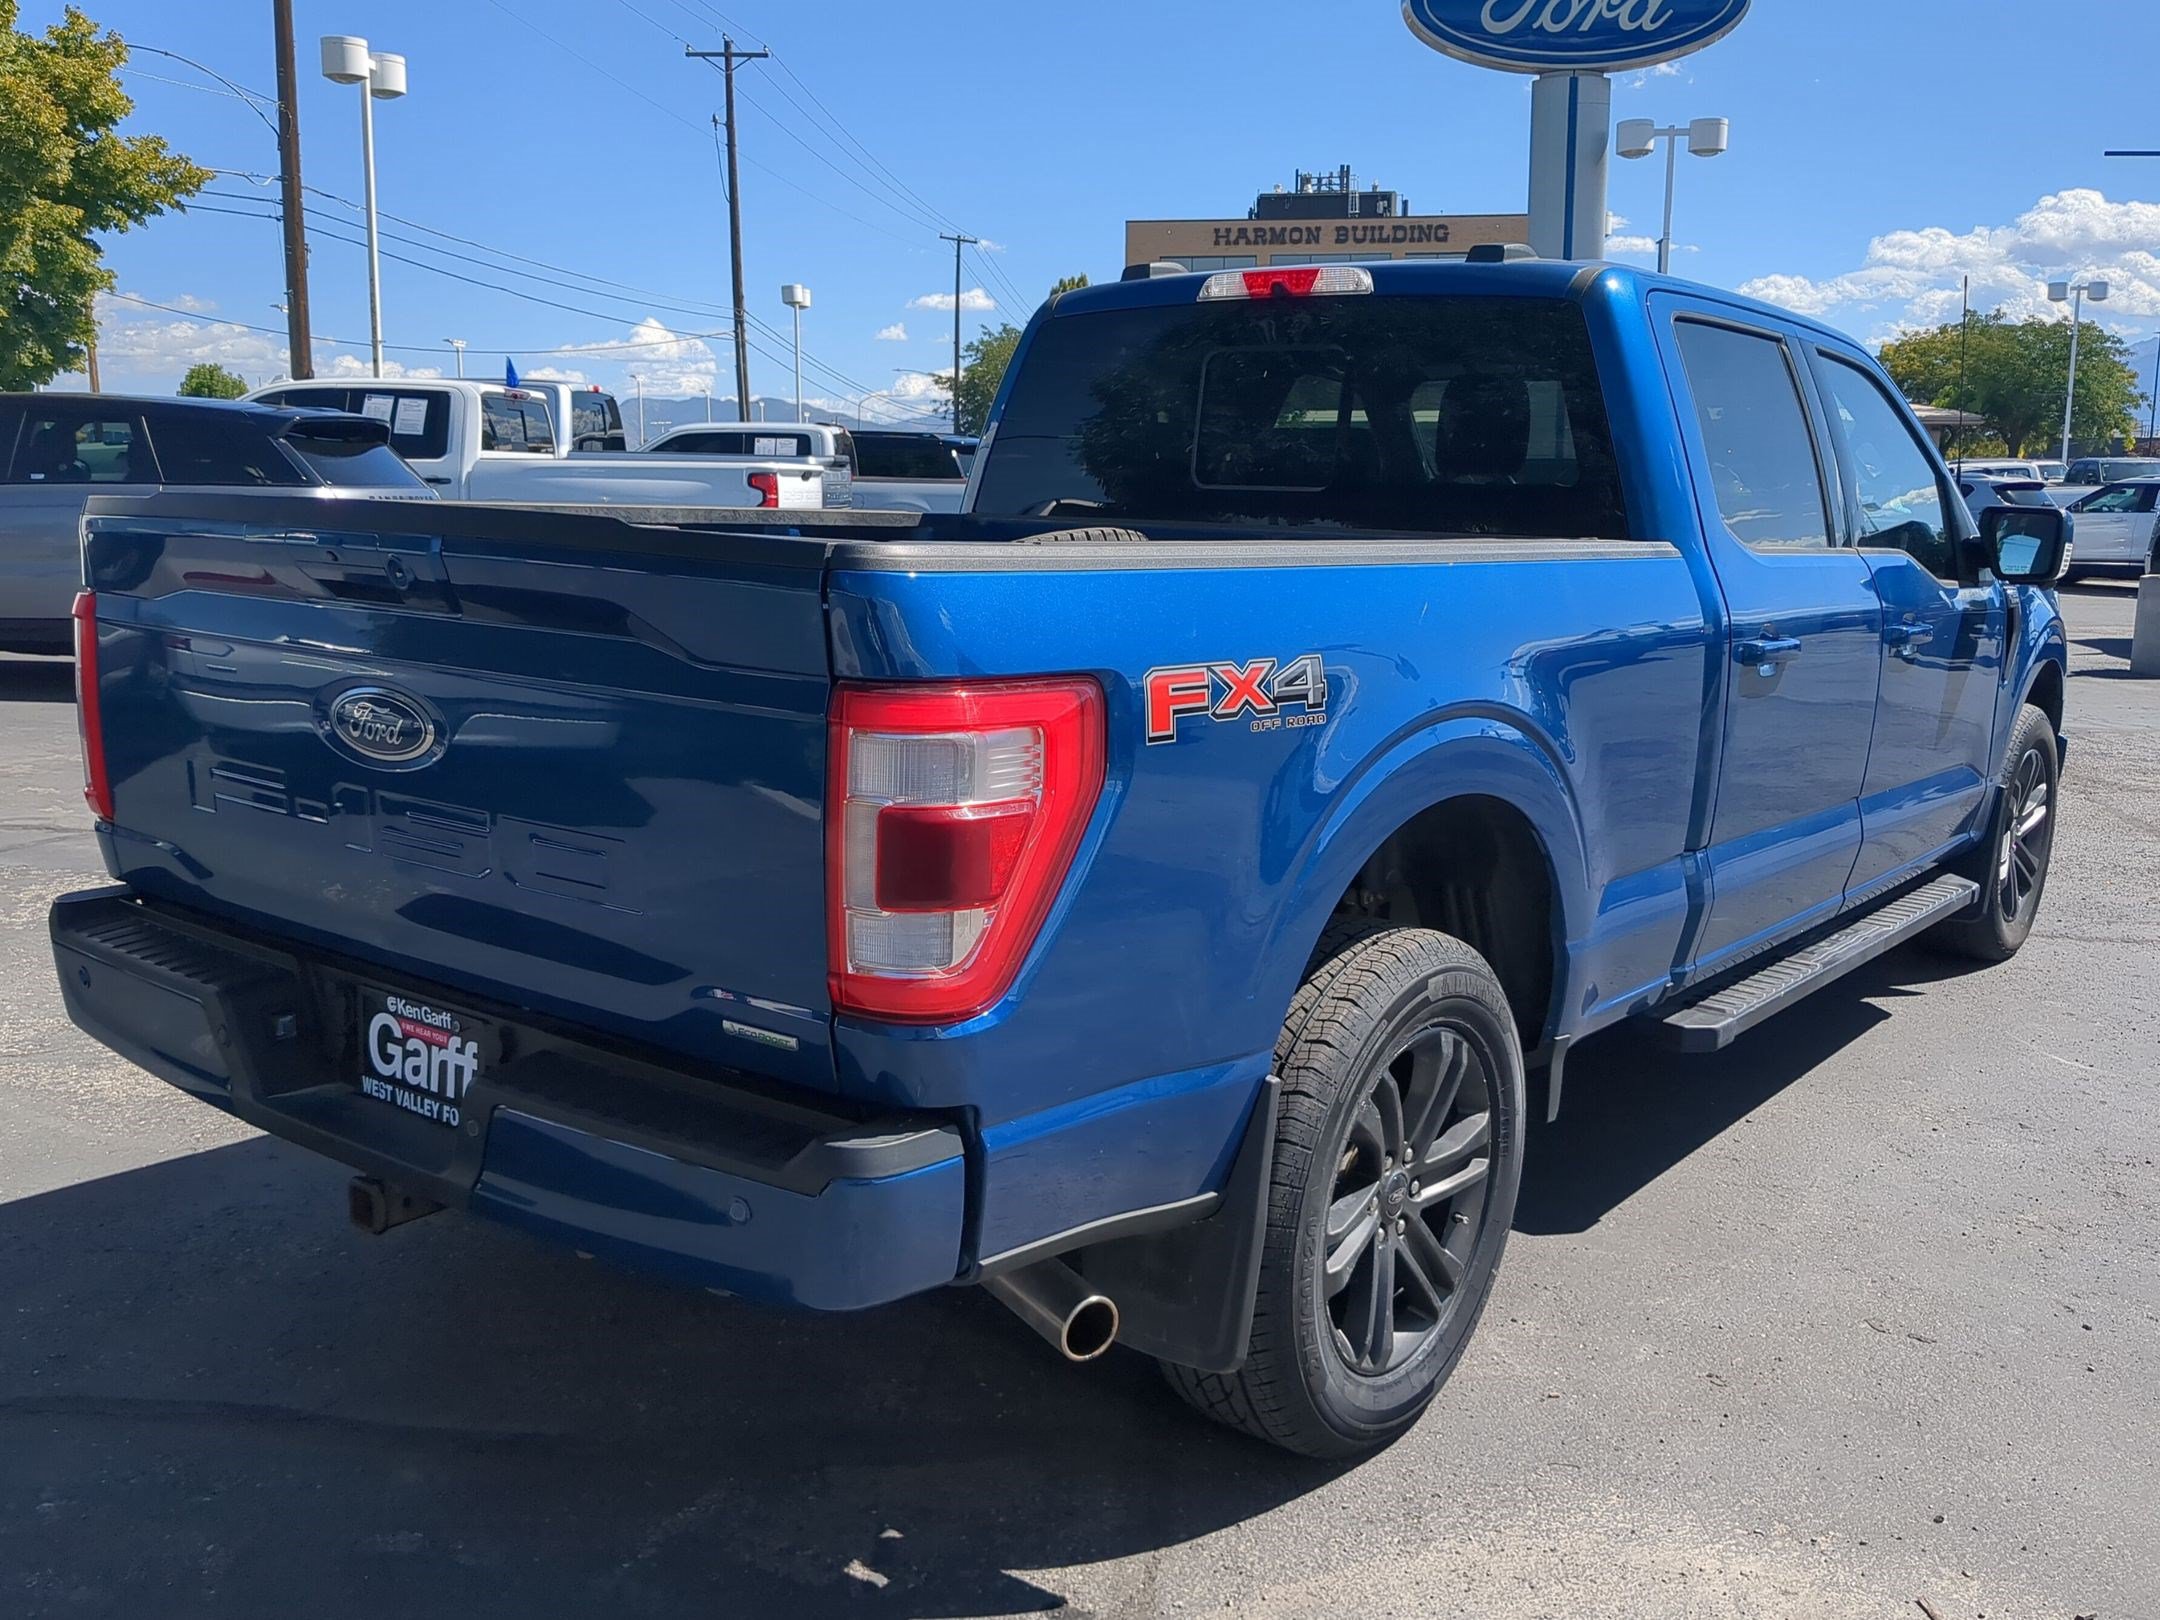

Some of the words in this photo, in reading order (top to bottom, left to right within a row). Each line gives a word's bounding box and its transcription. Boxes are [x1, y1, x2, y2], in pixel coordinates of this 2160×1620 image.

[1213, 226, 1322, 246] HARMON
[1334, 224, 1450, 244] BUILDING
[1143, 653, 1327, 746] FX4
[348, 701, 403, 745] Ford
[1250, 718, 1281, 733] OFF
[1285, 713, 1327, 729] ROAD
[369, 1012, 478, 1099] Garff
[362, 1075, 393, 1102] WEST
[395, 1087, 440, 1119] VALLEY
